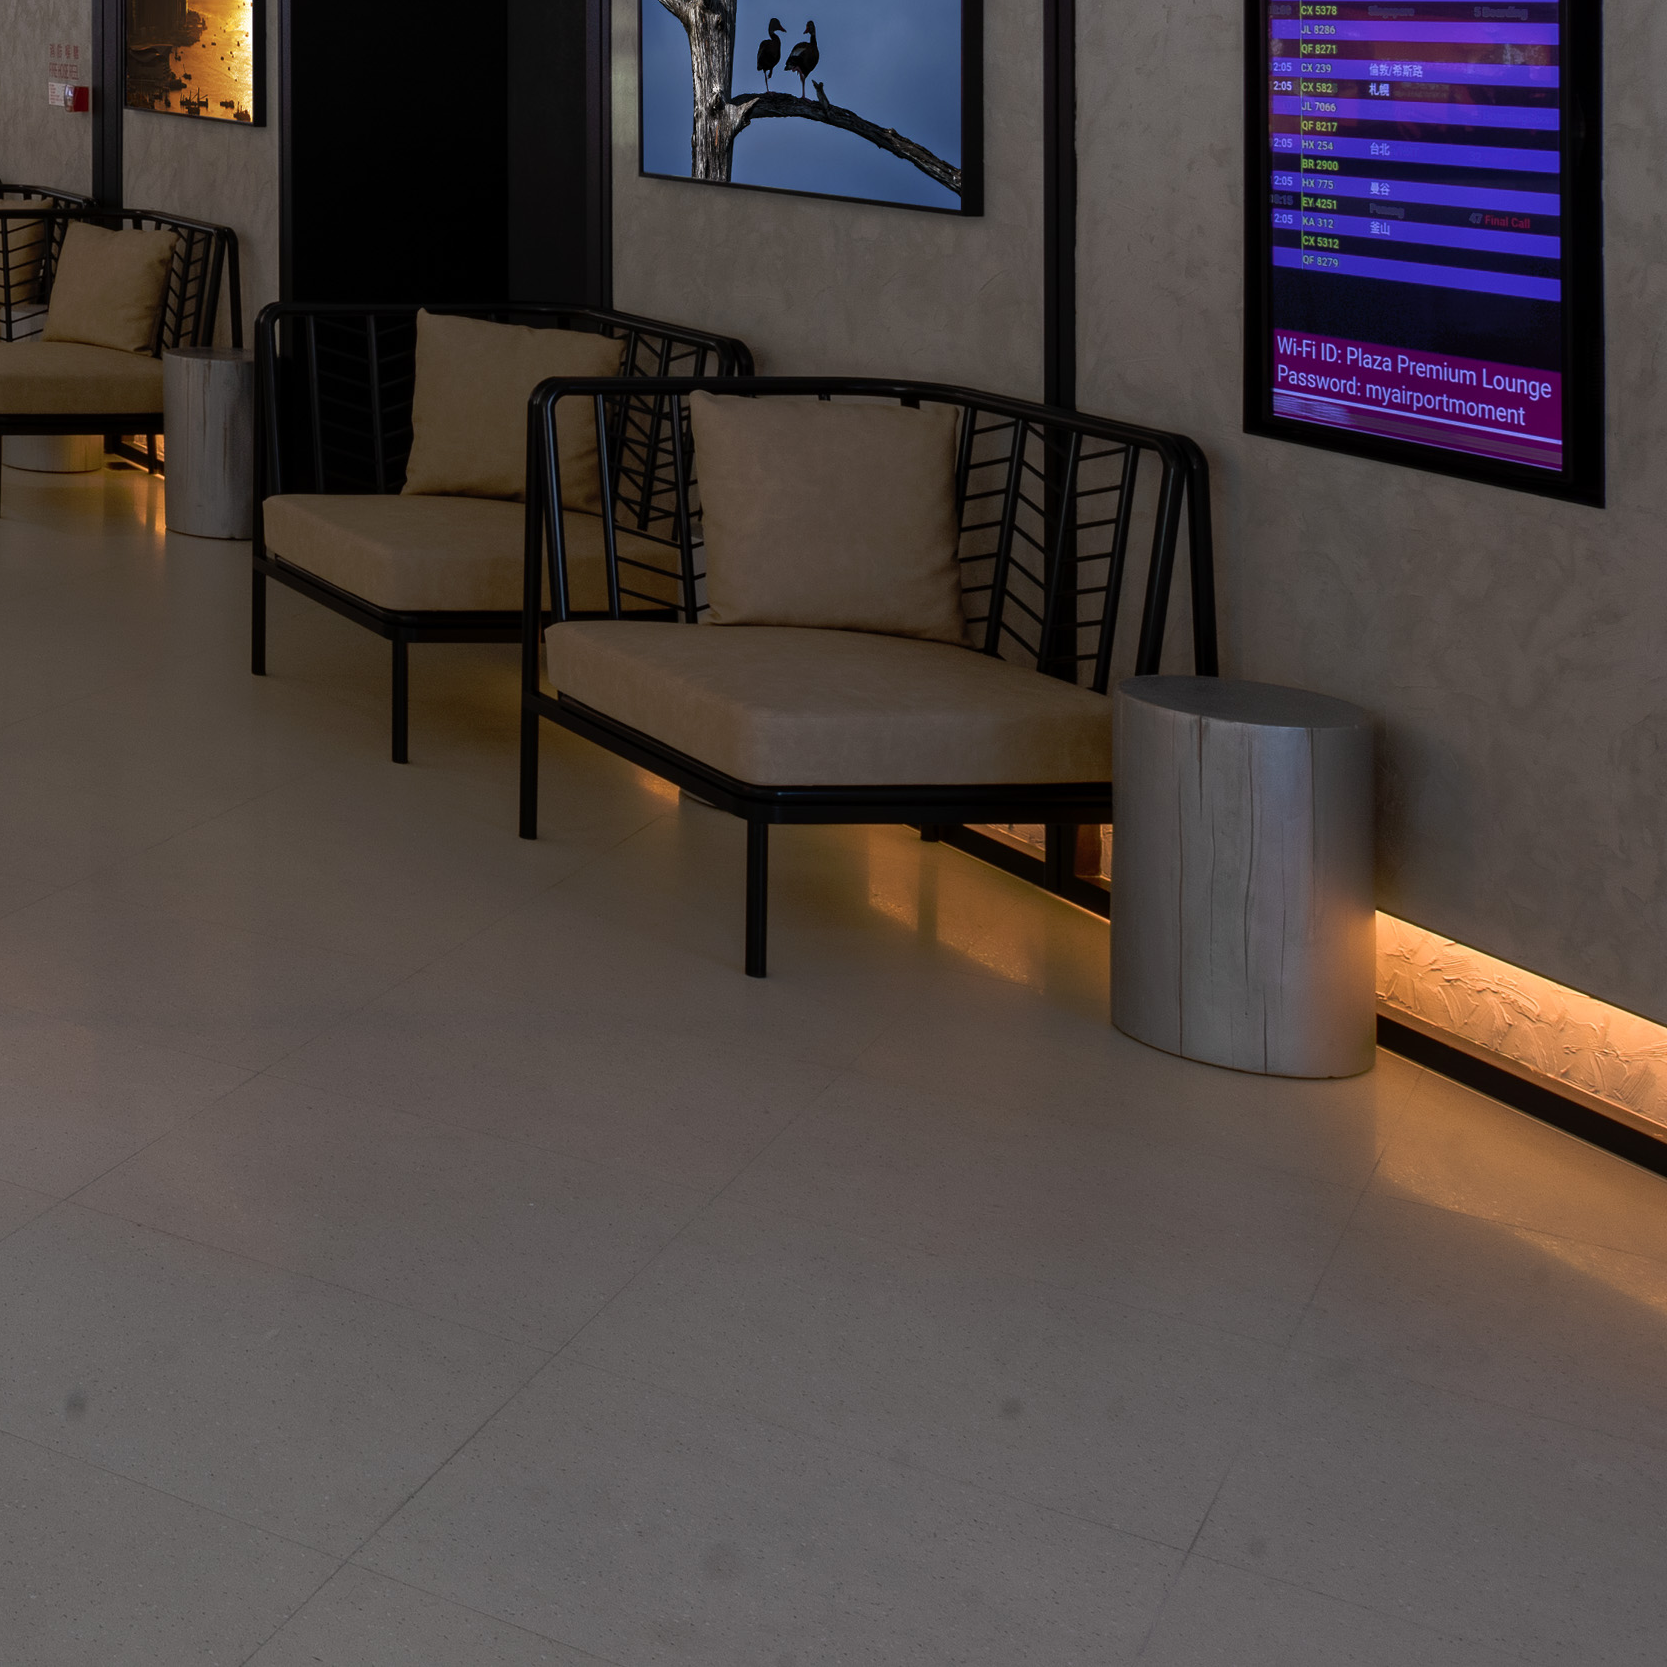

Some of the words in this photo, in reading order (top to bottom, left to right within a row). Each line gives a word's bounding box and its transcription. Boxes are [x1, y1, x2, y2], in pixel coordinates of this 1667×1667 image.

[1300, 5, 1313, 16] CX
[1315, 5, 1338, 16] 5378
[1301, 25, 1312, 35] JL
[1313, 24, 1336, 35] 8286
[1301, 43, 1313, 55] QF
[1269, 62, 1292, 72] 2:05
[1300, 63, 1313, 73] CX
[1315, 63, 1332, 73] 239
[1270, 80, 1293, 92] 2:05
[1301, 82, 1314, 92] CX
[1301, 102, 1312, 111] JL
[1314, 101, 1337, 112] 7066
[1302, 120, 1313, 131] QF
[1270, 137, 1293, 148] 2:05
[1302, 140, 1315, 149] HX
[1317, 140, 1334, 151] 254
[1369, 142, 1390, 156] 台北
[1302, 159, 1315, 169] BR
[1316, 159, 1339, 171] 2900
[1270, 175, 1293, 186] 2:05
[1302, 177, 1315, 188] HX
[1317, 179, 1334, 190] 775
[1369, 181, 1391, 196] 曼谷
[1302, 197, 1314, 208] EY
[1315, 199, 1338, 210] 4251
[1270, 213, 1294, 225] 2:05
[1302, 216, 1315, 227] KA
[1317, 218, 1334, 229] 312
[1369, 220, 1391, 236] 釜山
[1484, 214, 1509, 228] Final
[1511, 217, 1531, 230] Call
[1302, 235, 1315, 247] CX
[1317, 236, 1340, 250] 5312
[1303, 254, 1315, 266] QF
[1316, 256, 1339, 268] 8279
[1277, 335, 1316, 360] Wi-Fi
[1321, 342, 1342, 364] ID:
[1347, 346, 1392, 373] Plaza
[1397, 354, 1477, 387] Premium
[1482, 367, 1552, 402] Lounge
[1278, 363, 1361, 397] Password:
[1366, 382, 1526, 426] myairportmoment
